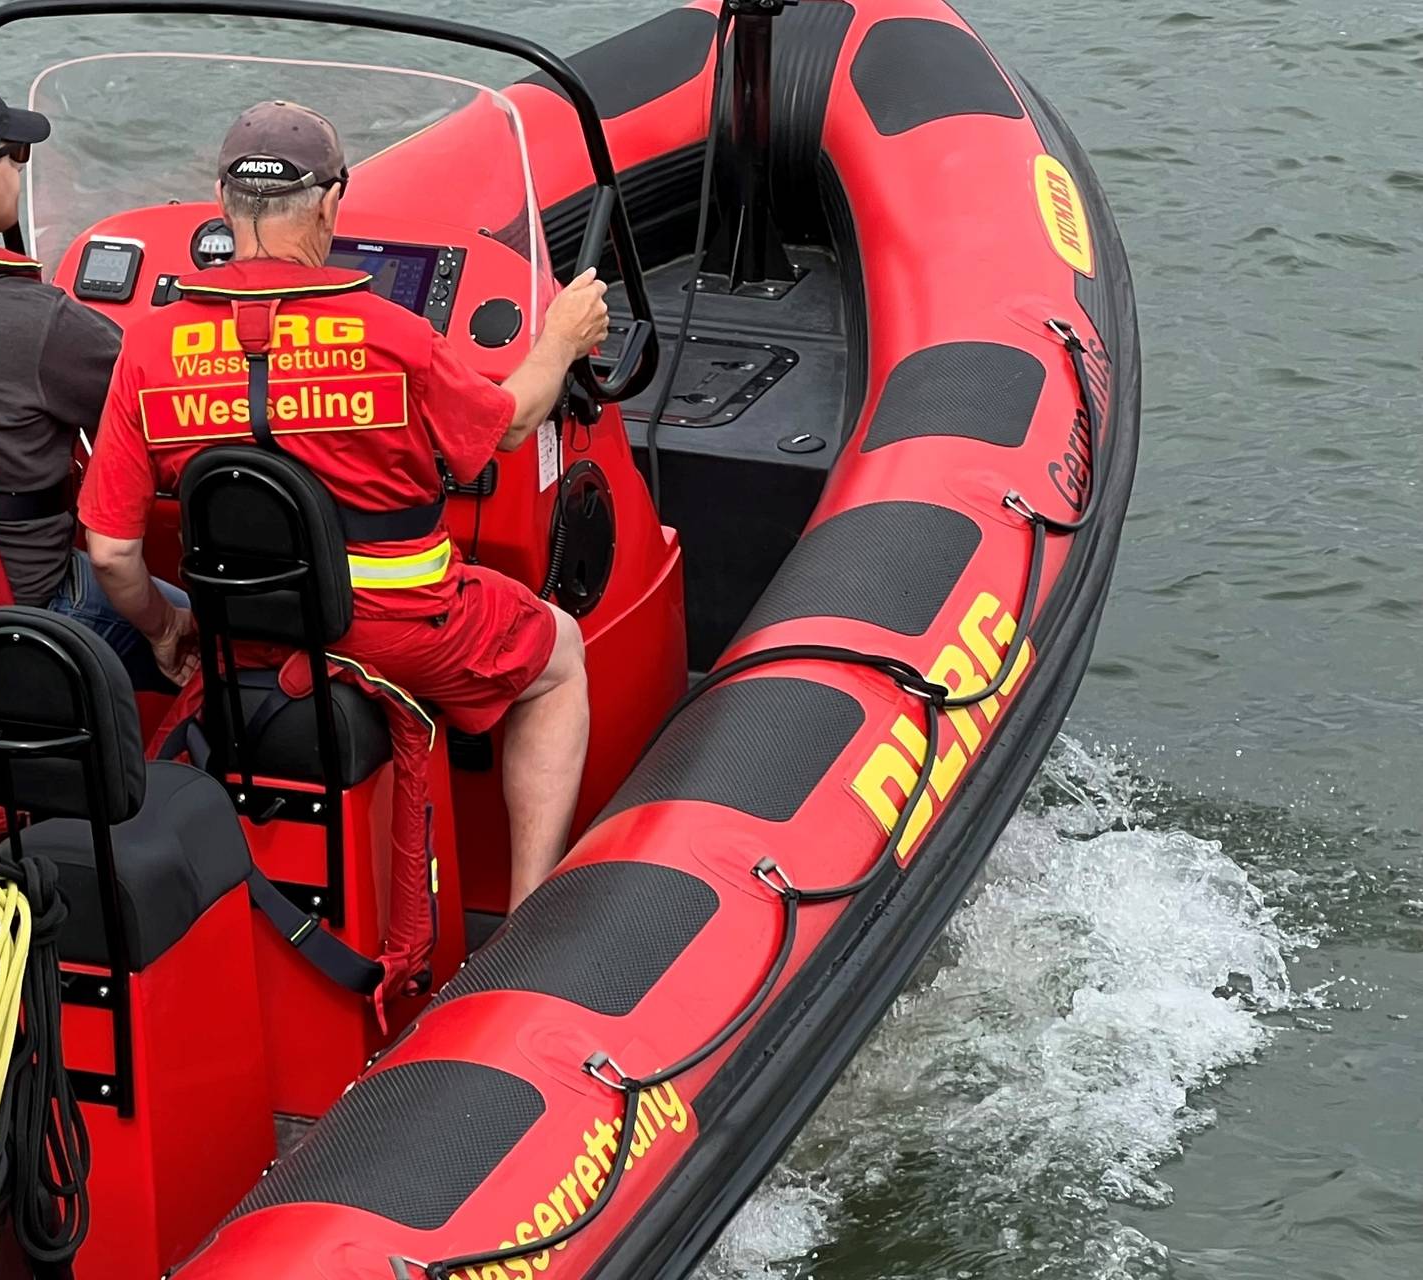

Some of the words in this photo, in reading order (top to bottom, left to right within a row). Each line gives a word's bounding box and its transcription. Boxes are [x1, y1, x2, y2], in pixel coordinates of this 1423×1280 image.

[236, 161, 284, 175] MUSTO
[172, 348, 366, 379] Wasserettung
[850, 591, 1031, 860] DLRG
